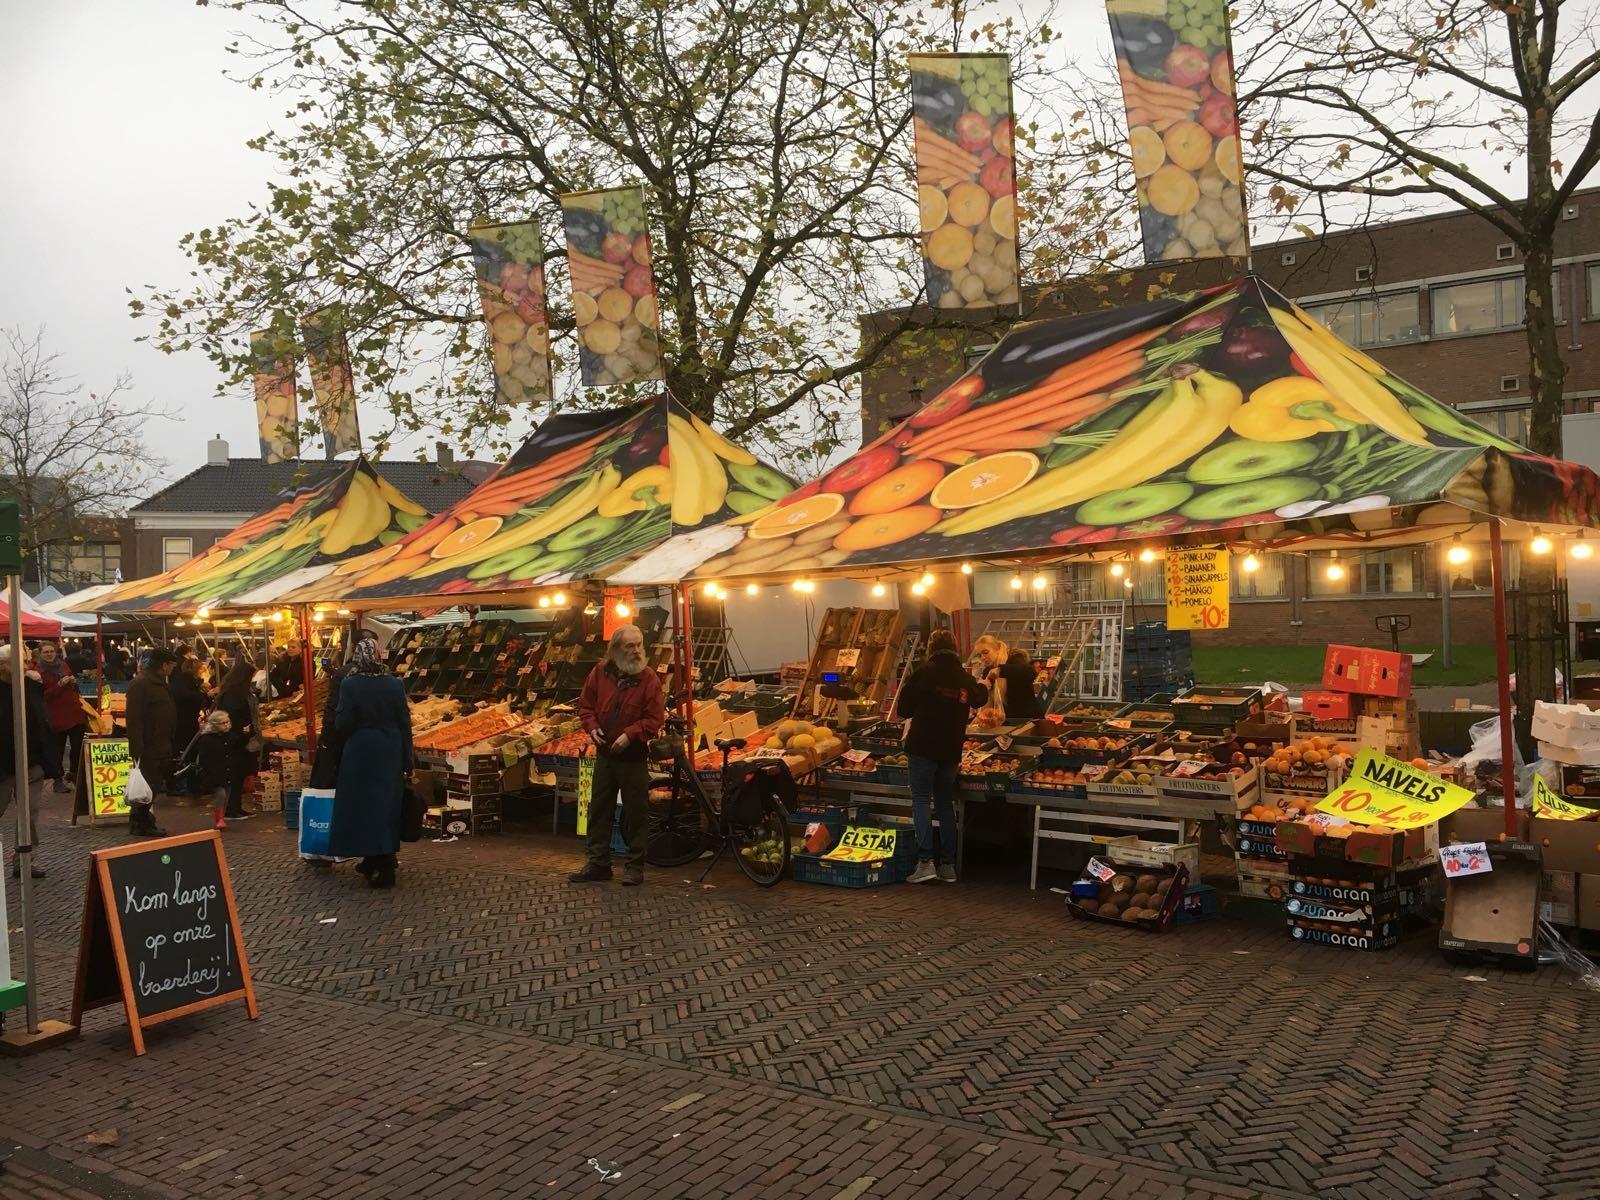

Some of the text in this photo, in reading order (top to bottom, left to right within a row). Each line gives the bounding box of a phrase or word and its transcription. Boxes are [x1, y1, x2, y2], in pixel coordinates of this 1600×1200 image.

[1184, 563, 1216, 573] BANANEN
[1185, 586, 1213, 596] MANGO
[1184, 597, 1212, 607] POMELO
[93, 743, 120, 754] MARKT
[95, 766, 117, 784] 30
[1364, 758, 1446, 803] NAVELS
[1098, 784, 1144, 794] FRUITMASTERS
[1168, 779, 1221, 792] FRUITMASTERS
[101, 797, 116, 813] 2
[842, 831, 895, 851] ELSTAR
[125, 870, 217, 921] Kom langs
[1307, 884, 1370, 902] sunaran
[145, 924, 216, 959] op onze
[1305, 929, 1369, 949] sunaran
